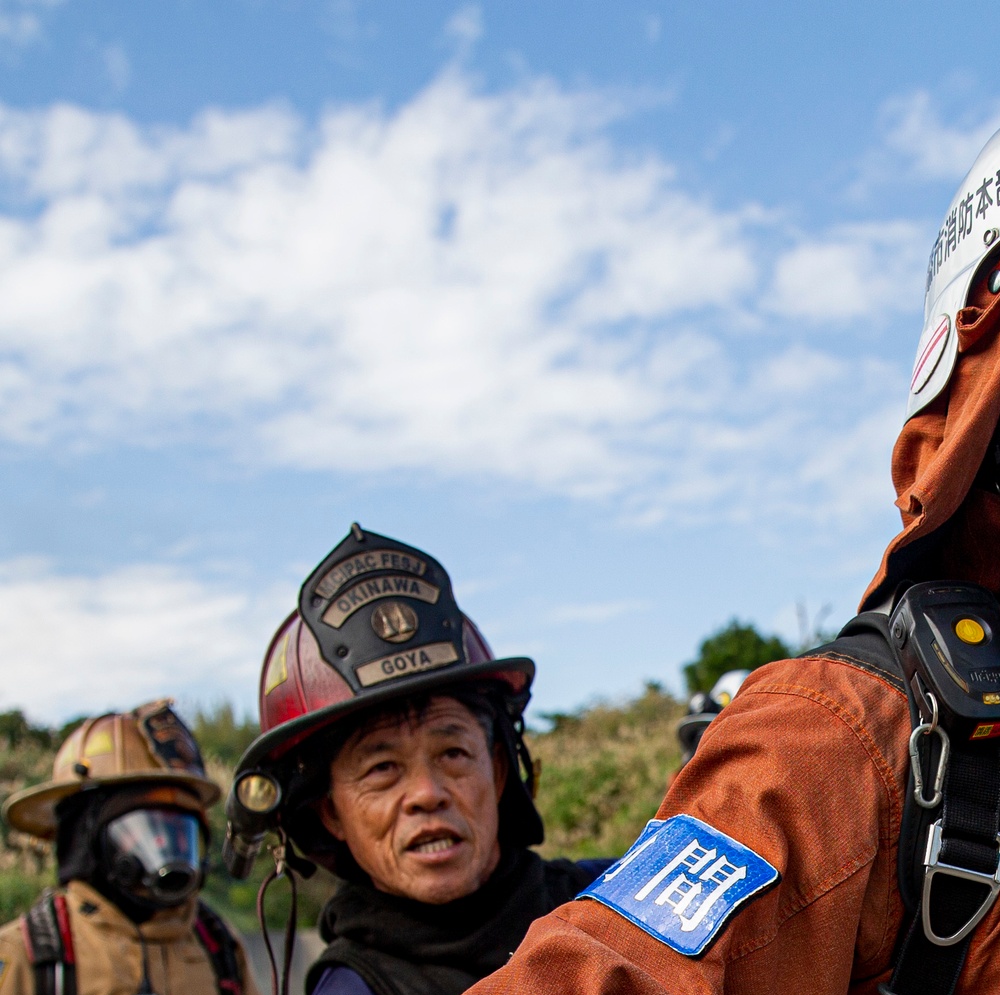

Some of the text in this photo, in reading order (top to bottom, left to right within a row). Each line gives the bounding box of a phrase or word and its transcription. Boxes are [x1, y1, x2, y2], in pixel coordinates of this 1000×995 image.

[336, 577, 421, 613] OKINAWA
[381, 650, 431, 676] GOYA
[603, 835, 748, 933] 間
